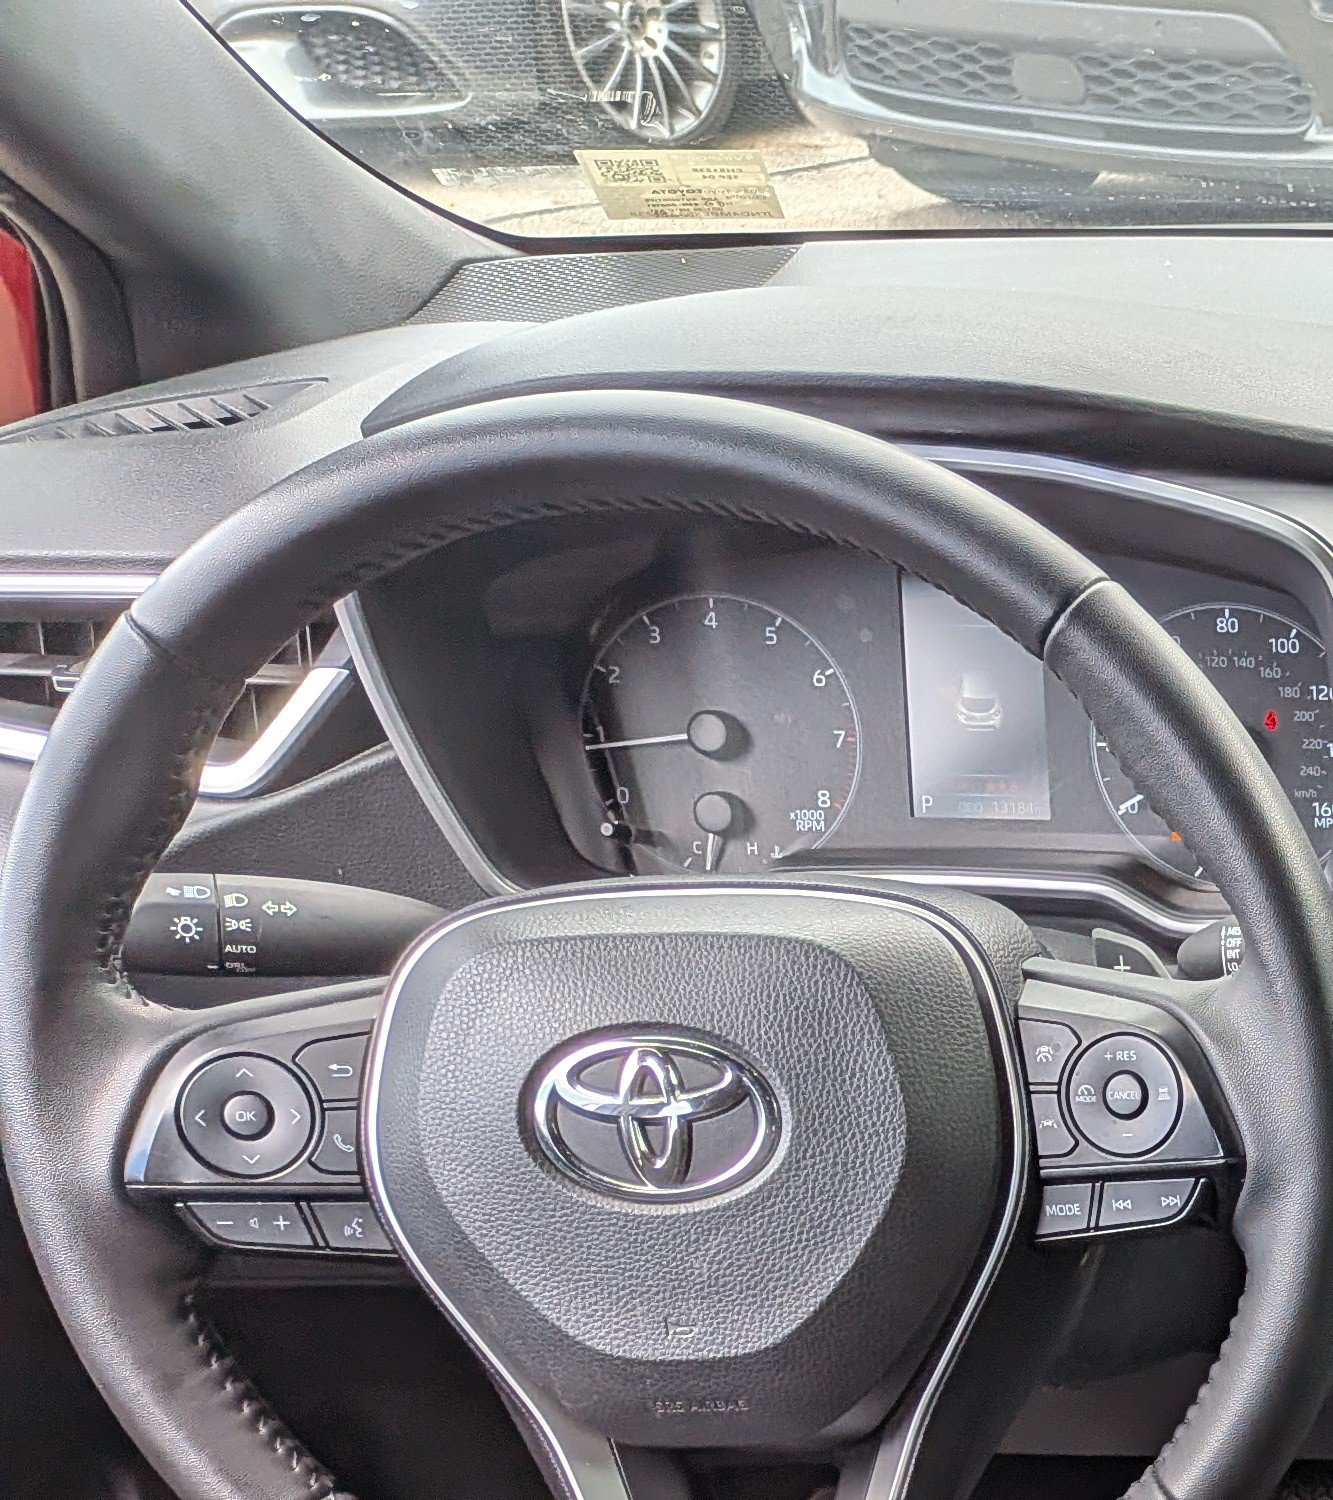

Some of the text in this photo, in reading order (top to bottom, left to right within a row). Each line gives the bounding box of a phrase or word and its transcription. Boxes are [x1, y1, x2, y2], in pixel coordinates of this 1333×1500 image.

[704, 612, 718, 628] 4
[1217, 618, 1238, 633] 80
[649, 626, 661, 643] 3
[765, 627, 777, 645] 5
[1269, 638, 1300, 653] 100
[1206, 656, 1228, 667] 120
[1233, 657, 1254, 668] 140
[608, 667, 620, 684] 2
[813, 669, 826, 686] 6
[1260, 667, 1282, 678] 160
[1279, 687, 1300, 698] 180
[1294, 711, 1315, 721] 200
[833, 731, 845, 748] 7
[1302, 739, 1323, 749] 220
[1300, 766, 1321, 776] 240
[616, 787, 629, 803] 0
[817, 790, 831, 807] 8
[922, 795, 933, 813] P
[789, 809, 825, 821] x1000
[795, 820, 825, 832] RPM
[1314, 817, 1333, 828] MP
[692, 841, 702, 854] C
[746, 842, 759, 855] H
[224, 945, 257, 953] AUTO
[1226, 938, 1242, 948] OFF
[1226, 950, 1240, 959] INT
[1116, 1051, 1137, 1060] RES
[1108, 1091, 1140, 1100] CANCEL
[236, 1110, 256, 1121] OK
[1046, 1204, 1081, 1216] MODE
